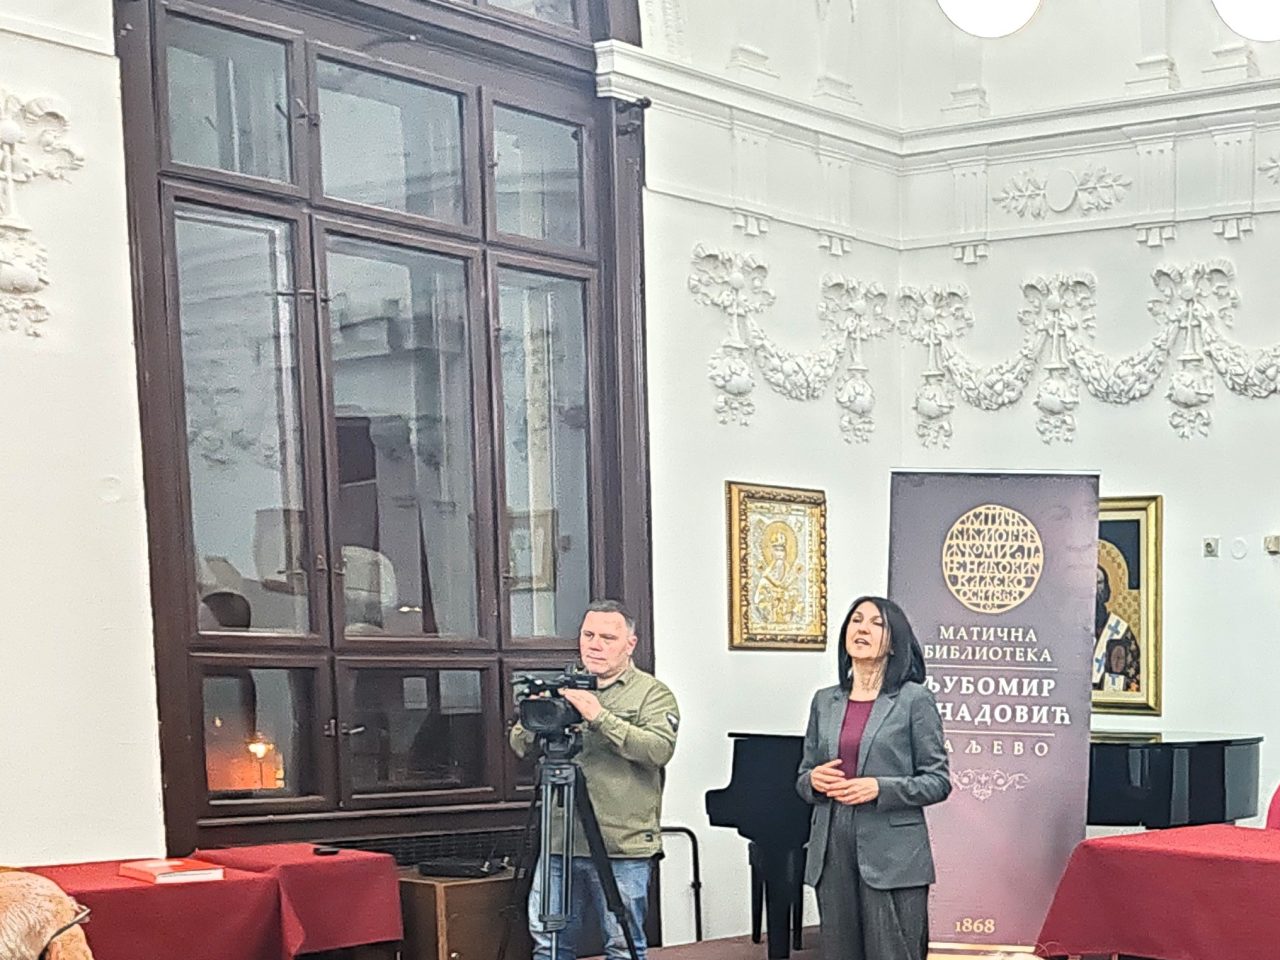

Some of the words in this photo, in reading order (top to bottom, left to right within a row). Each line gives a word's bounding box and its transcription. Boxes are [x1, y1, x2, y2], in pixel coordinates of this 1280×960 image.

[939, 626, 1038, 642] МАТИЧНА
[923, 645, 1053, 662] БИБЛИОТЕКА
[922, 675, 1056, 697] ЉУБОМИР
[937, 702, 1072, 727] НАДОВИЋ
[943, 739, 1049, 757] АЉЕВО
[954, 917, 996, 934] 1868
